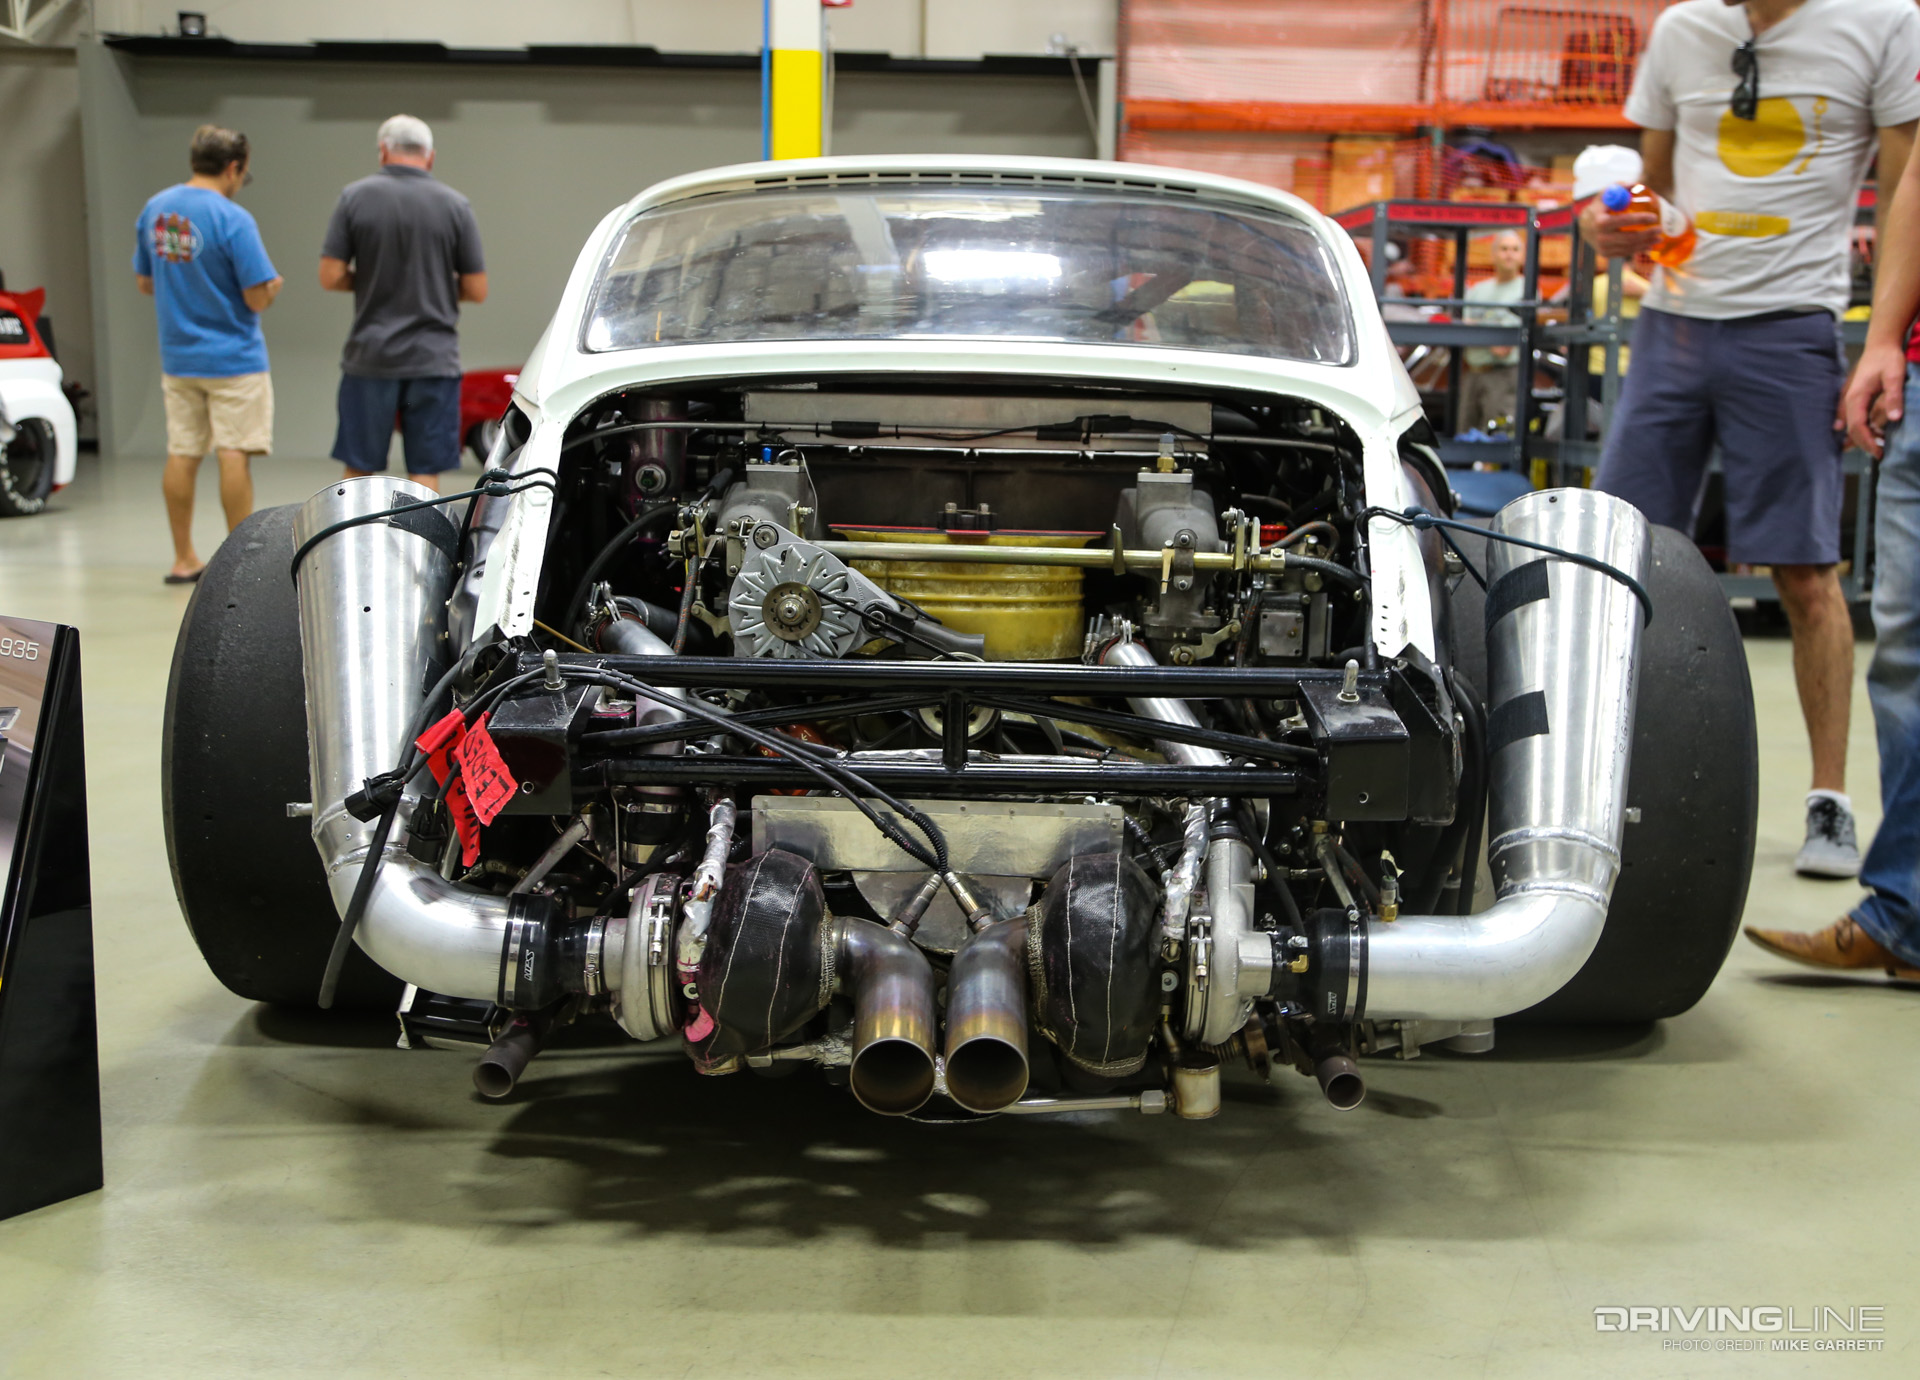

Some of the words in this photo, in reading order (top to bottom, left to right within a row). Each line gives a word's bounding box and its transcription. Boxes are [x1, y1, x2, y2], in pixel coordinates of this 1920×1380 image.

[0, 637, 39, 660] 935
[1618, 702, 1630, 755] RIGHT
[1625, 655, 1635, 699] SIDE
[463, 729, 510, 815] LEADED
